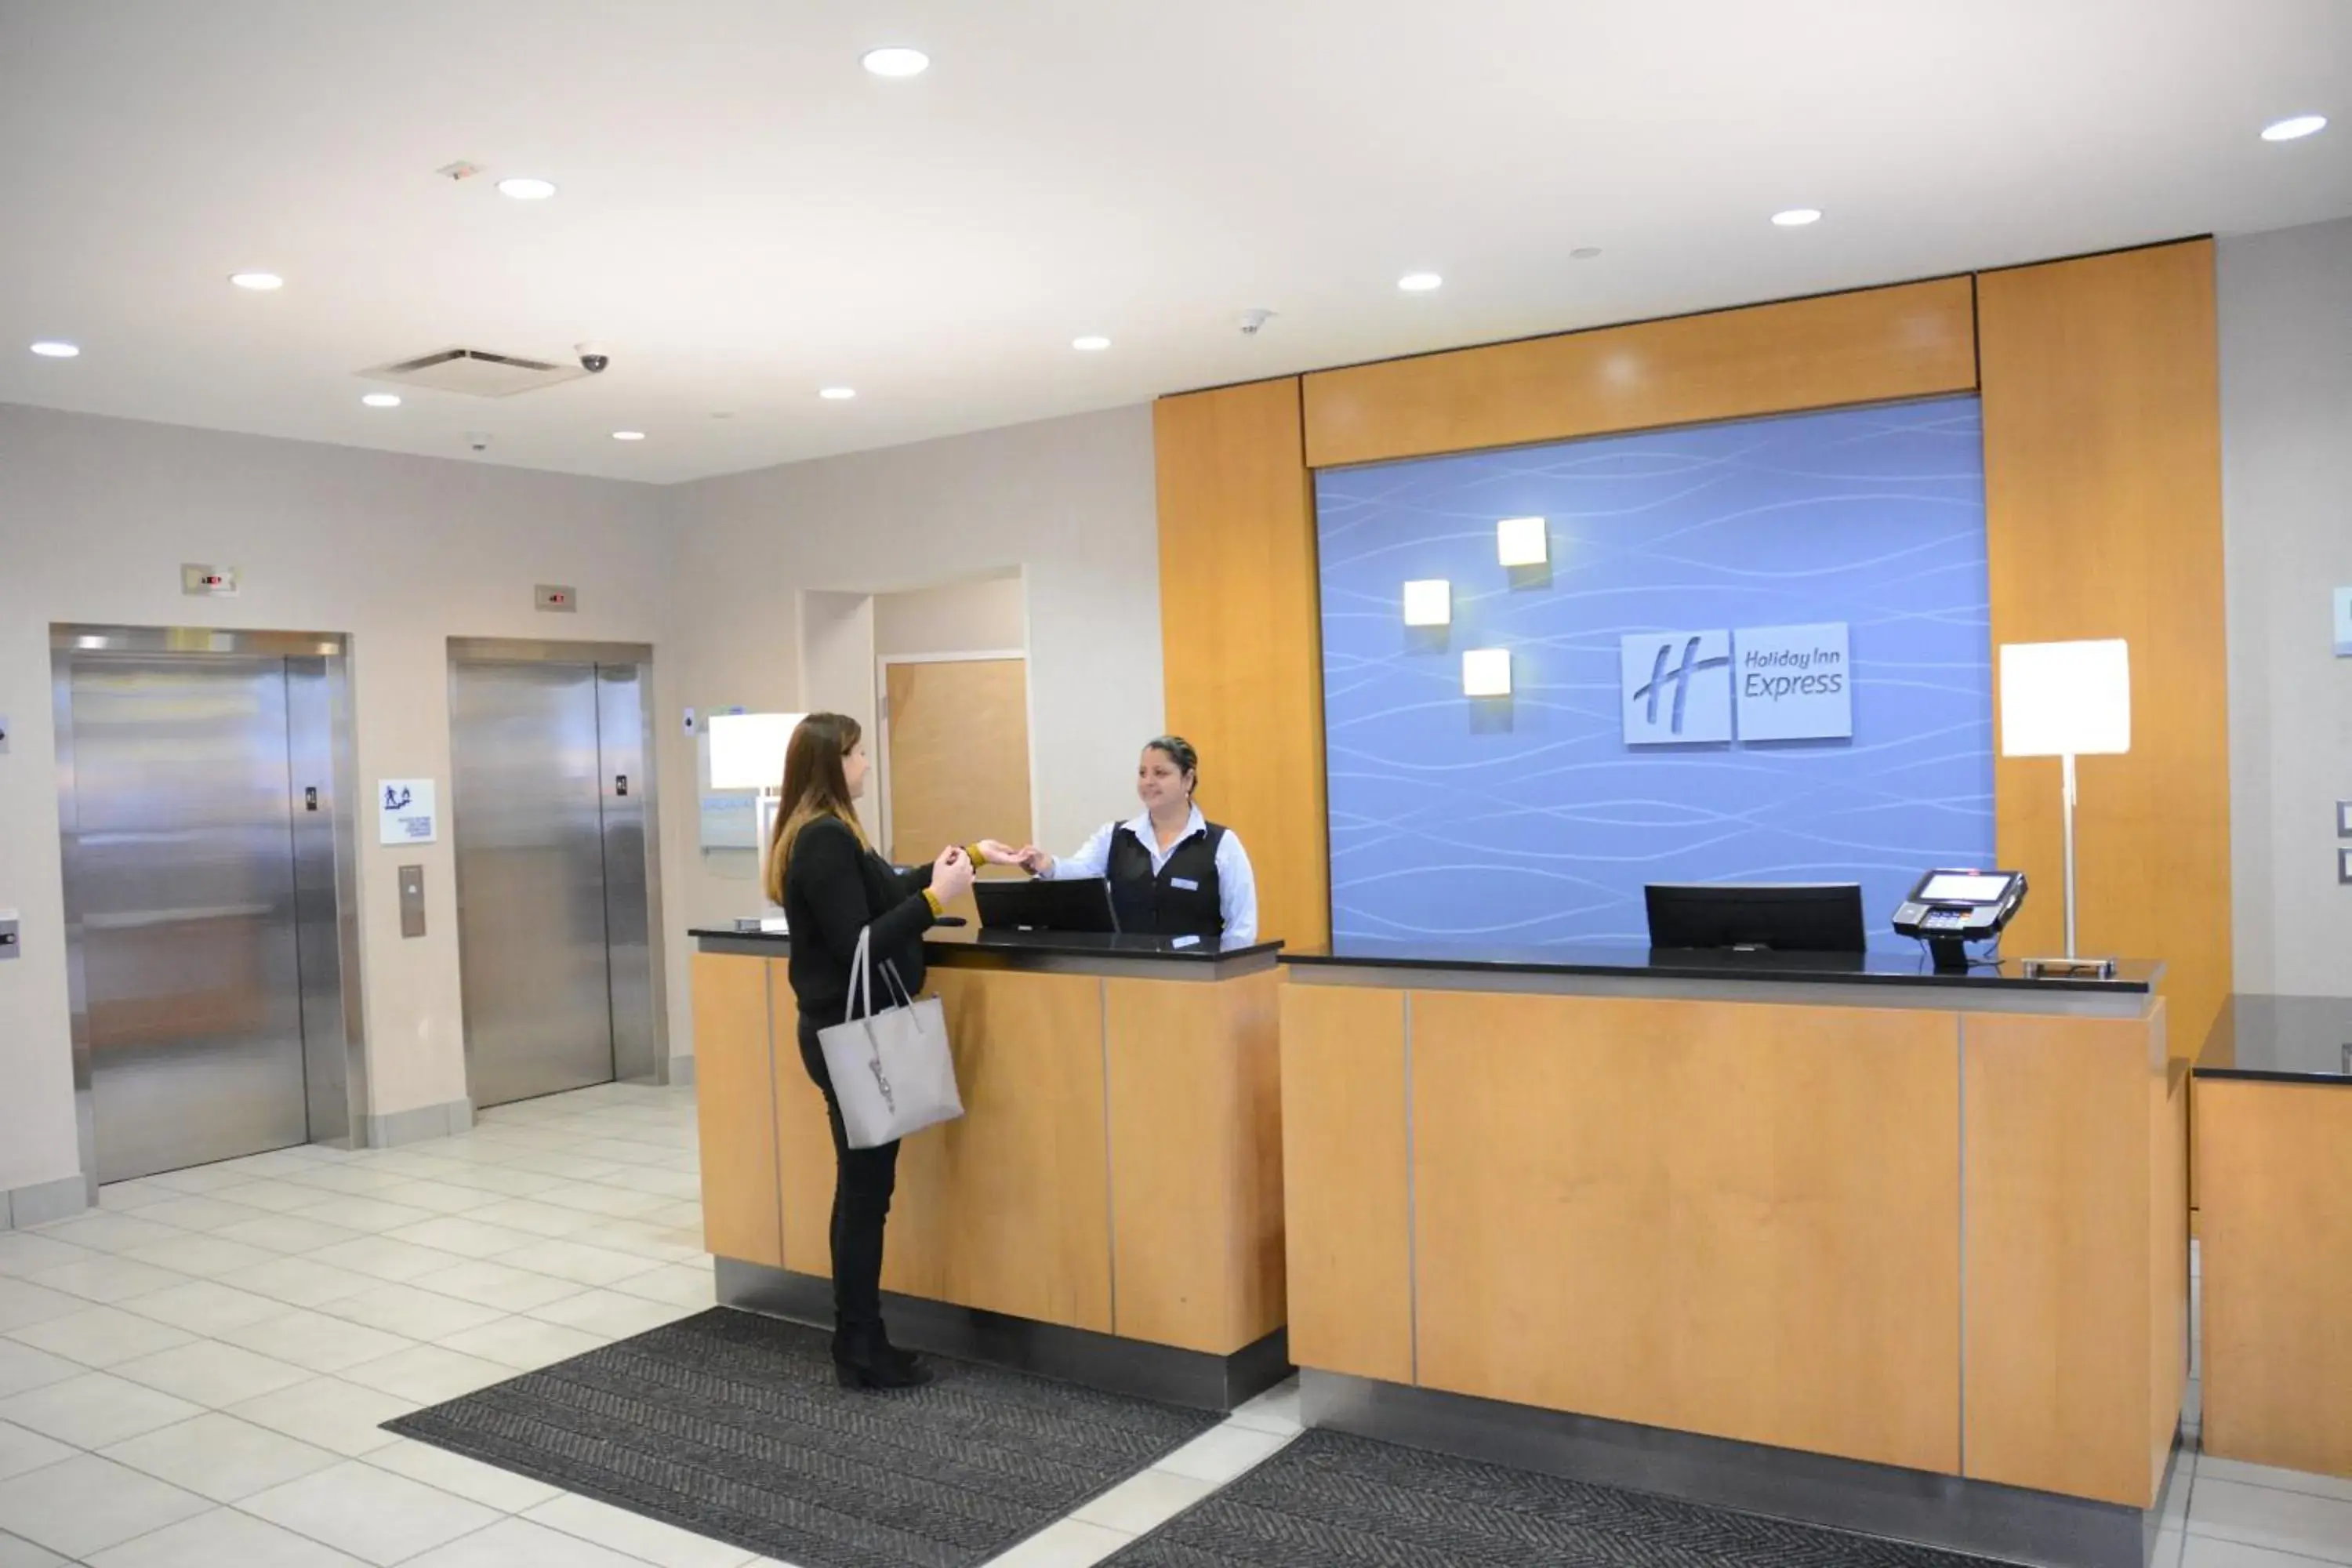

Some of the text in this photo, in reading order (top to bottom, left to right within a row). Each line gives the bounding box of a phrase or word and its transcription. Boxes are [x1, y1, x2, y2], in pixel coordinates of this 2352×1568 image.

[1745, 647, 1840, 669] Holiday Inn
[1633, 636, 1730, 735] H
[1745, 673, 1842, 702] Express
